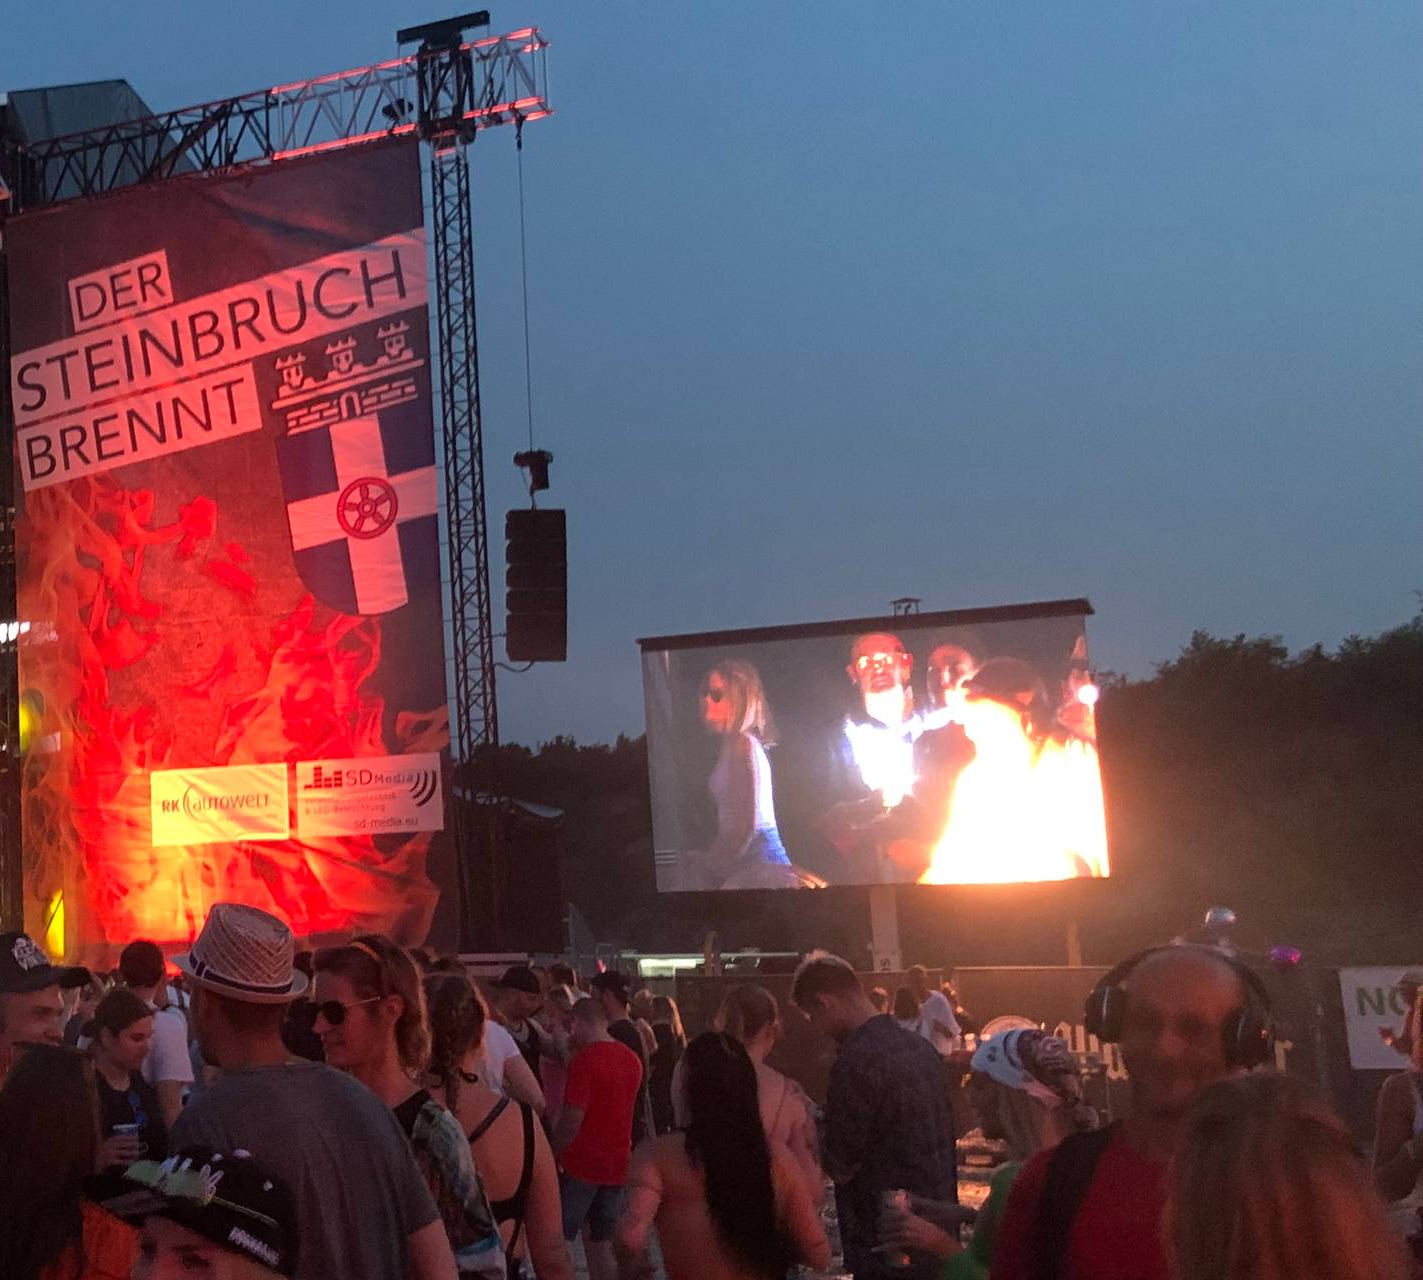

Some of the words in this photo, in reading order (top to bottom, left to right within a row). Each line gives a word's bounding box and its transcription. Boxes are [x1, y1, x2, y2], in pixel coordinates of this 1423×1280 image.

[75, 263, 165, 322] DER
[17, 249, 407, 412] STEINBRUCH
[25, 378, 245, 480] BRENNT
[162, 799, 179, 813] RK
[346, 769, 373, 786] SD
